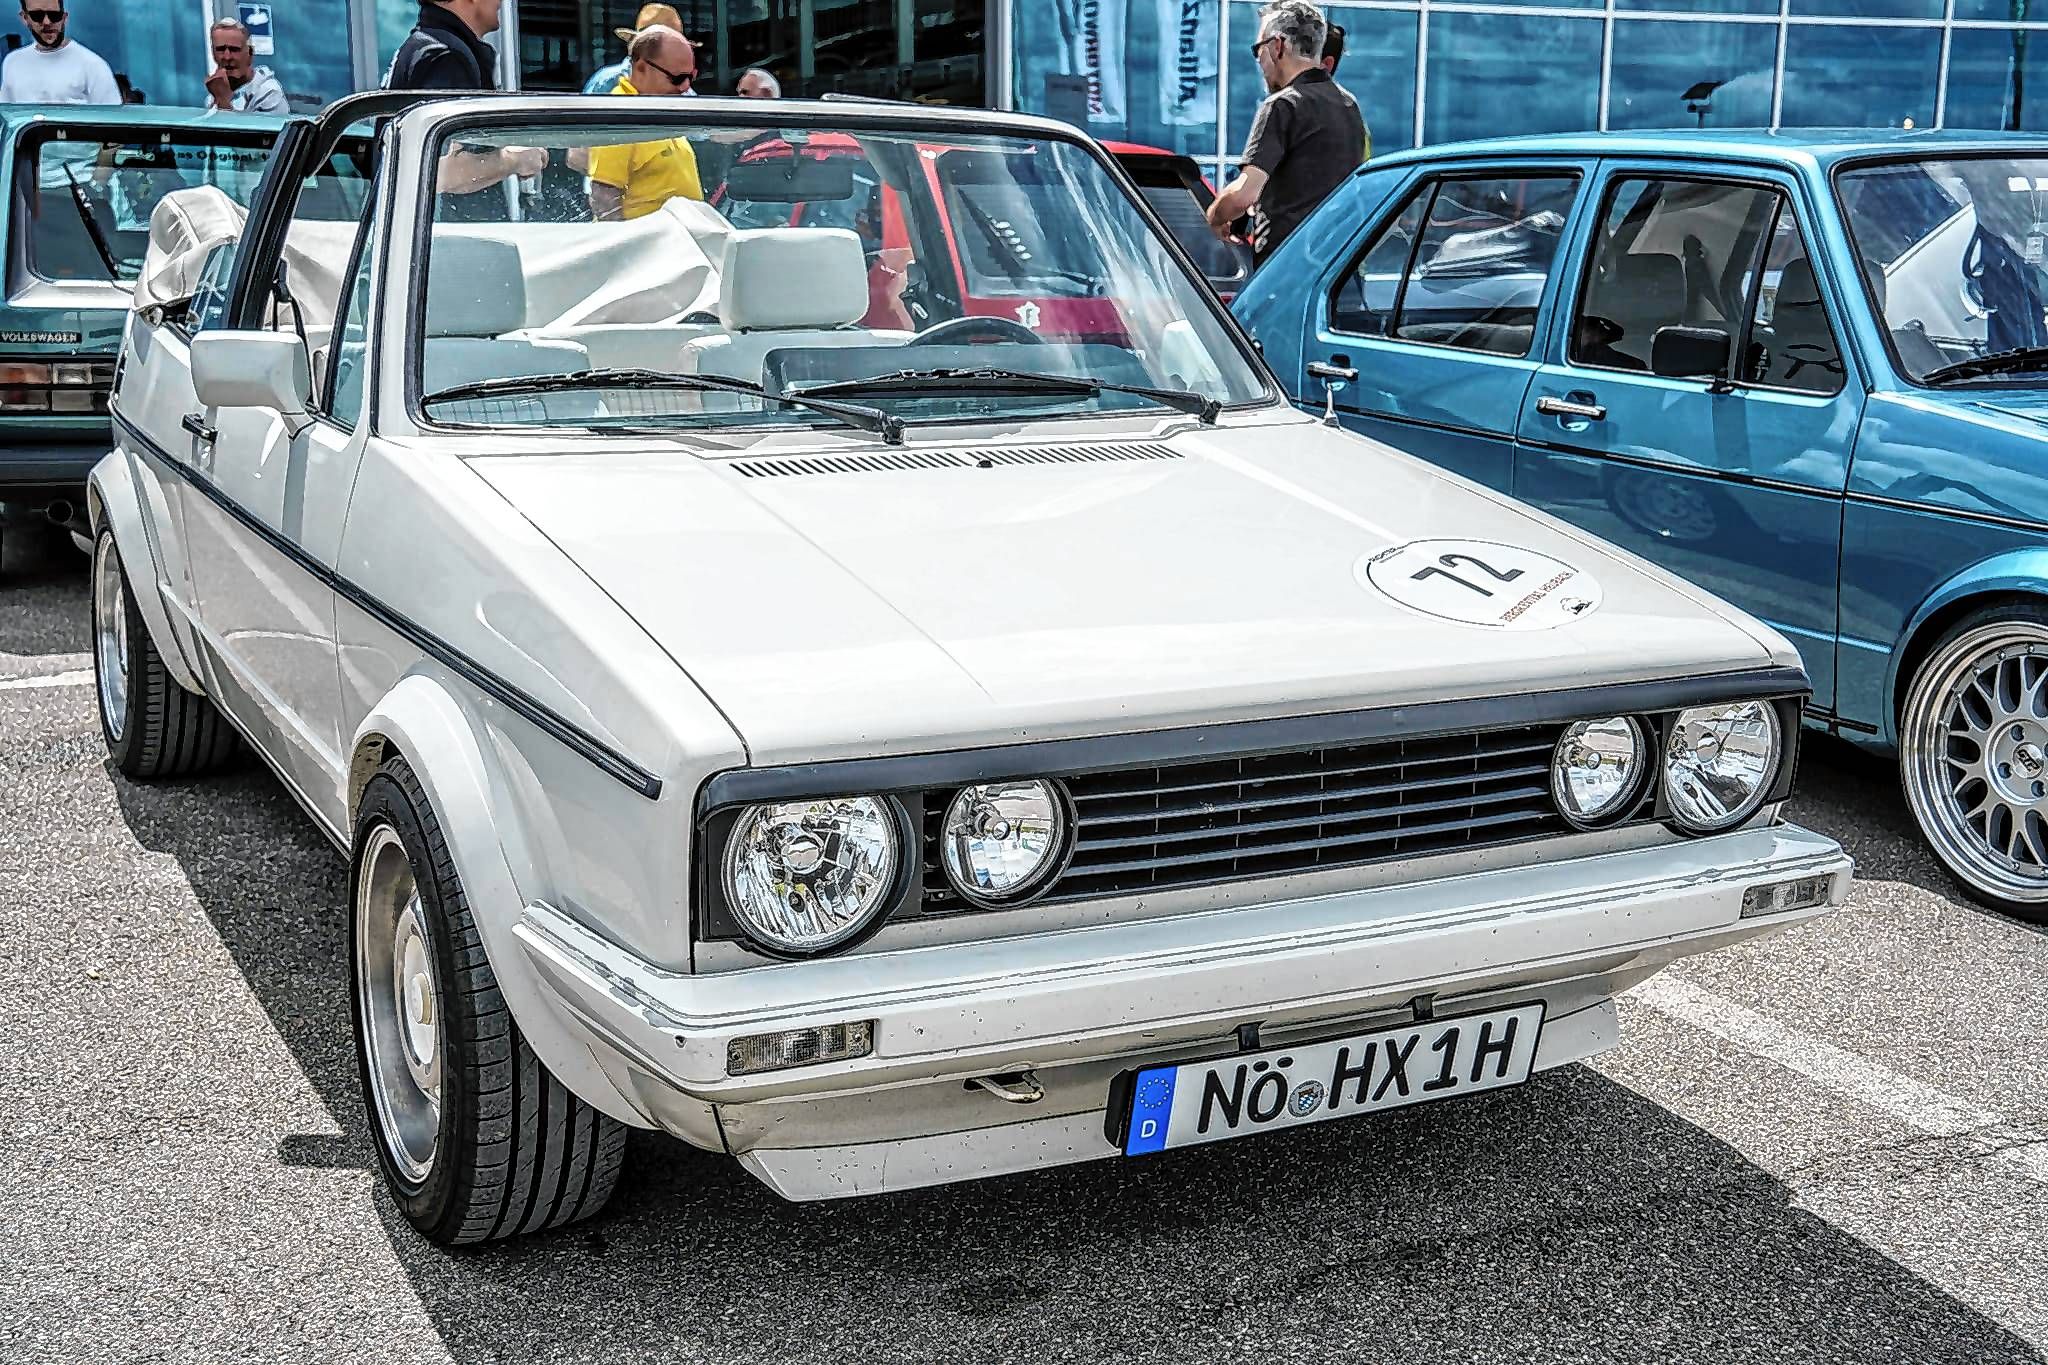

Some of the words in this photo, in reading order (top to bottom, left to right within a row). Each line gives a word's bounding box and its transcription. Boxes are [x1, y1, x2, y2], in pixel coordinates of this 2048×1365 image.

[1, 331, 77, 342] VOLKSWAGEN
[1197, 1056, 1294, 1133] NÖ
[1140, 1119, 1157, 1139] D
